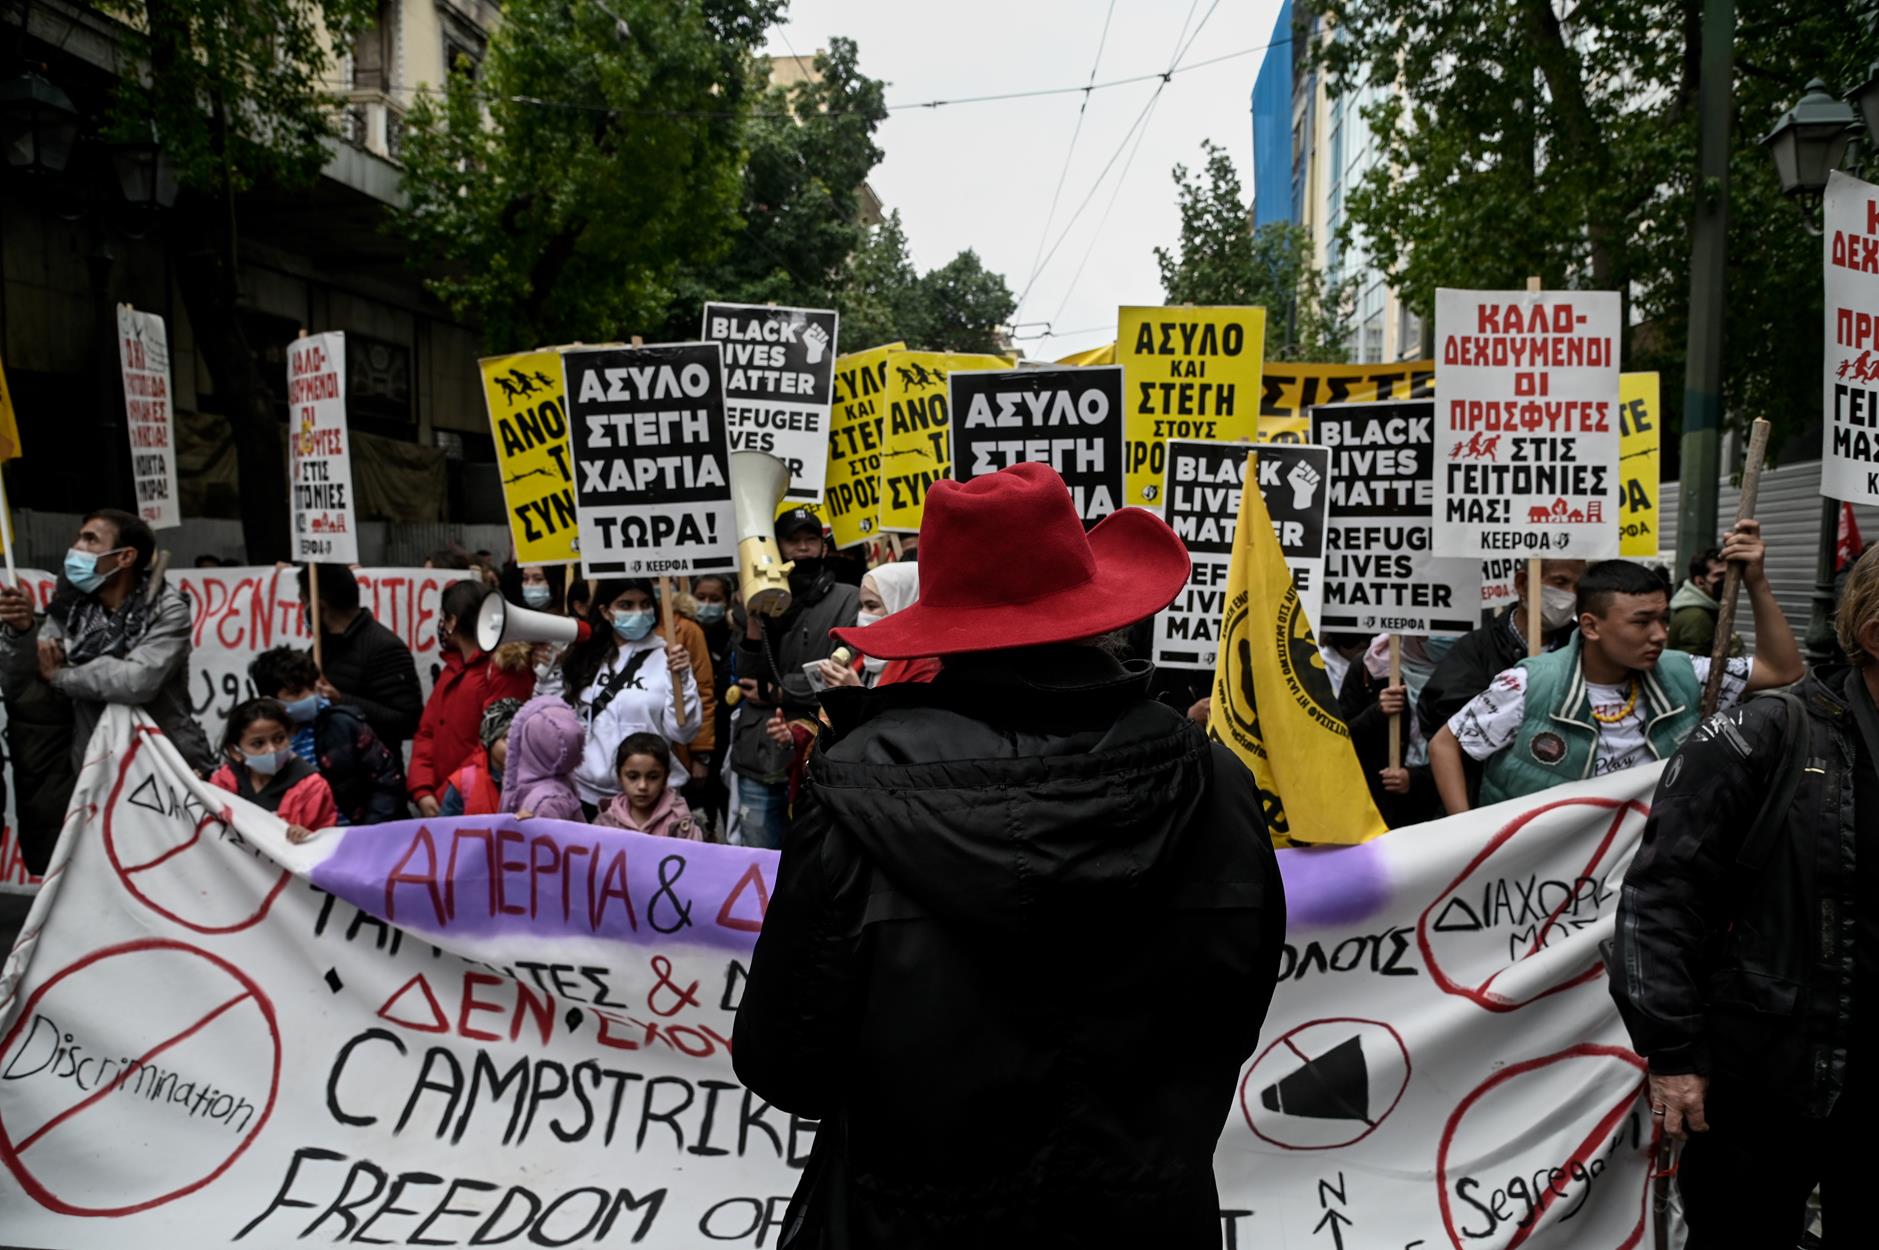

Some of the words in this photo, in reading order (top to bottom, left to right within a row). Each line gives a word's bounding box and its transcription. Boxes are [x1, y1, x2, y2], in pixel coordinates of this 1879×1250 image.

[711, 317, 798, 344] BLACK
[1477, 303, 1587, 335] ΚΑΛΟ-
[1837, 307, 1879, 351] ΠΡ
[725, 343, 786, 368] IVES
[1134, 322, 1244, 357] ΑΣΥΛΟ
[1444, 335, 1612, 367] ΔΕΧΟΥΜΕΝΟΙ
[578, 363, 711, 404] ΑΣΥΛΟ
[726, 367, 817, 396] ATTER
[1170, 360, 1206, 378] ΚΑΙ
[1514, 372, 1549, 397] ΟΙ
[844, 399, 876, 421] ΚΑΙ
[890, 393, 949, 436] ΑΝΟ
[963, 388, 1110, 429] ΑΣΥΛΟ
[1138, 382, 1236, 416] ΣΤΕΓΗ
[585, 409, 711, 449] ΣΤΕΓΗ
[727, 407, 820, 432] EFUGEE
[1153, 420, 1217, 438] ΣΤΟΥΣ
[1320, 417, 1432, 447] BLACK
[1450, 400, 1610, 433] ΠΡΟΣΦΥΓΕΣ
[730, 430, 775, 452] VES
[970, 438, 1105, 475] ΣΤΕΓΗ
[1510, 437, 1577, 463] ΣΤΙΣ
[303, 460, 330, 482] ΣΤΙΣ
[547, 442, 574, 483] Τ
[579, 454, 726, 493] ΧΑΡΤΙΑ
[1330, 480, 1433, 507] MATTE
[1446, 464, 1608, 496] ΓΕΙΤΟΝΙΕΣ
[1445, 498, 1512, 524] ΜΑΣ!
[593, 512, 719, 549] ΤΩΡΑ!
[1172, 515, 1305, 547] MATER
[1326, 526, 1432, 552] REFUG
[1480, 531, 1550, 550] ΚΕΕΡΦΑ
[646, 560, 689, 572] ΚΕΕΡΦΑ
[1324, 555, 1414, 579] LIVES
[1323, 582, 1453, 608] MATTER
[1379, 616, 1426, 631] ΚΕΕΡΦΑ
[384, 825, 638, 932] ΑΠΕΡΓΙΑ
[646, 854, 693, 934] &
[647, 955, 701, 1017] &
[375, 972, 556, 1047] ΔΕΝ
[2, 1014, 255, 1134] Discrimination
[325, 1026, 822, 1170] CAMPSTRIKE
[231, 1145, 669, 1247] FREEDOM
[698, 1195, 793, 1250] OF
[1318, 1171, 1347, 1209] N
